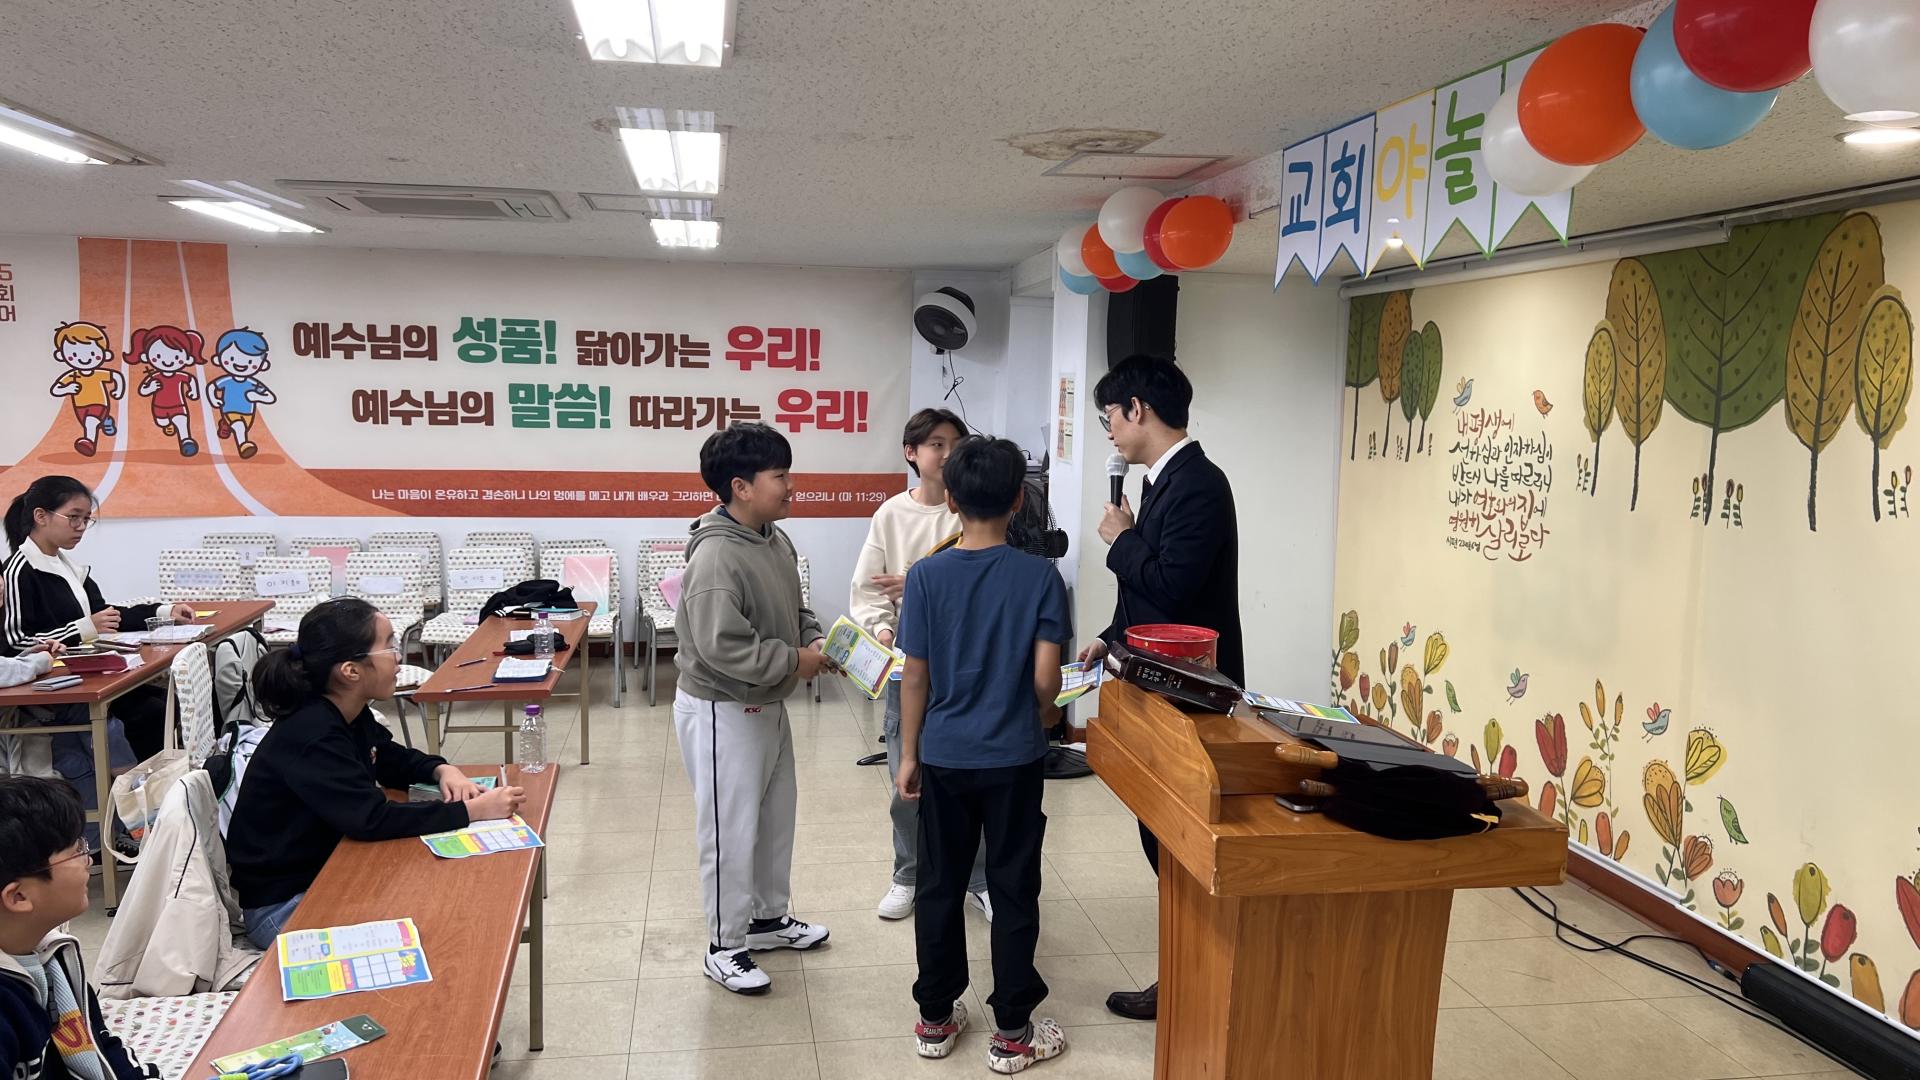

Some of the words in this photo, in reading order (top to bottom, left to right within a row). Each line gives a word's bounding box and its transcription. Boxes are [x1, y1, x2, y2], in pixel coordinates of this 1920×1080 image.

[293, 321, 438, 361] 예수님의
[452, 316, 558, 365] 성품!
[575, 330, 711, 369] 닮아가는
[725, 325, 821, 371] 우리!
[351, 389, 495, 426] 예수님의
[508, 383, 611, 429] 말씀!
[629, 395, 762, 430] 따라가는
[775, 388, 869, 433] 우리!
[1449, 435, 1503, 465] 선하심과
[1504, 430, 1553, 464] 인자하심이
[1452, 461, 1482, 487] 반드시
[1483, 465, 1509, 493] 나를
[1510, 462, 1552, 494] 따르리니
[372, 488, 395, 500] 나는
[397, 489, 432, 500] 마음이
[434, 489, 480, 500] 온유하고
[482, 489, 526, 501] 겸손하니
[528, 490, 551, 501] 나의
[553, 490, 587, 501] 멍에를
[588, 490, 611, 501] 메고
[613, 491, 635, 502] 내게
[637, 491, 670, 502] 배우라
[672, 491, 713, 502] 그리하면
[795, 491, 835, 502] 얻으리니
[838, 492, 853, 502] (마
[856, 492, 887, 502] 11:29)
[1448, 487, 1472, 508] 내가
[1448, 509, 1480, 533] 영원히
